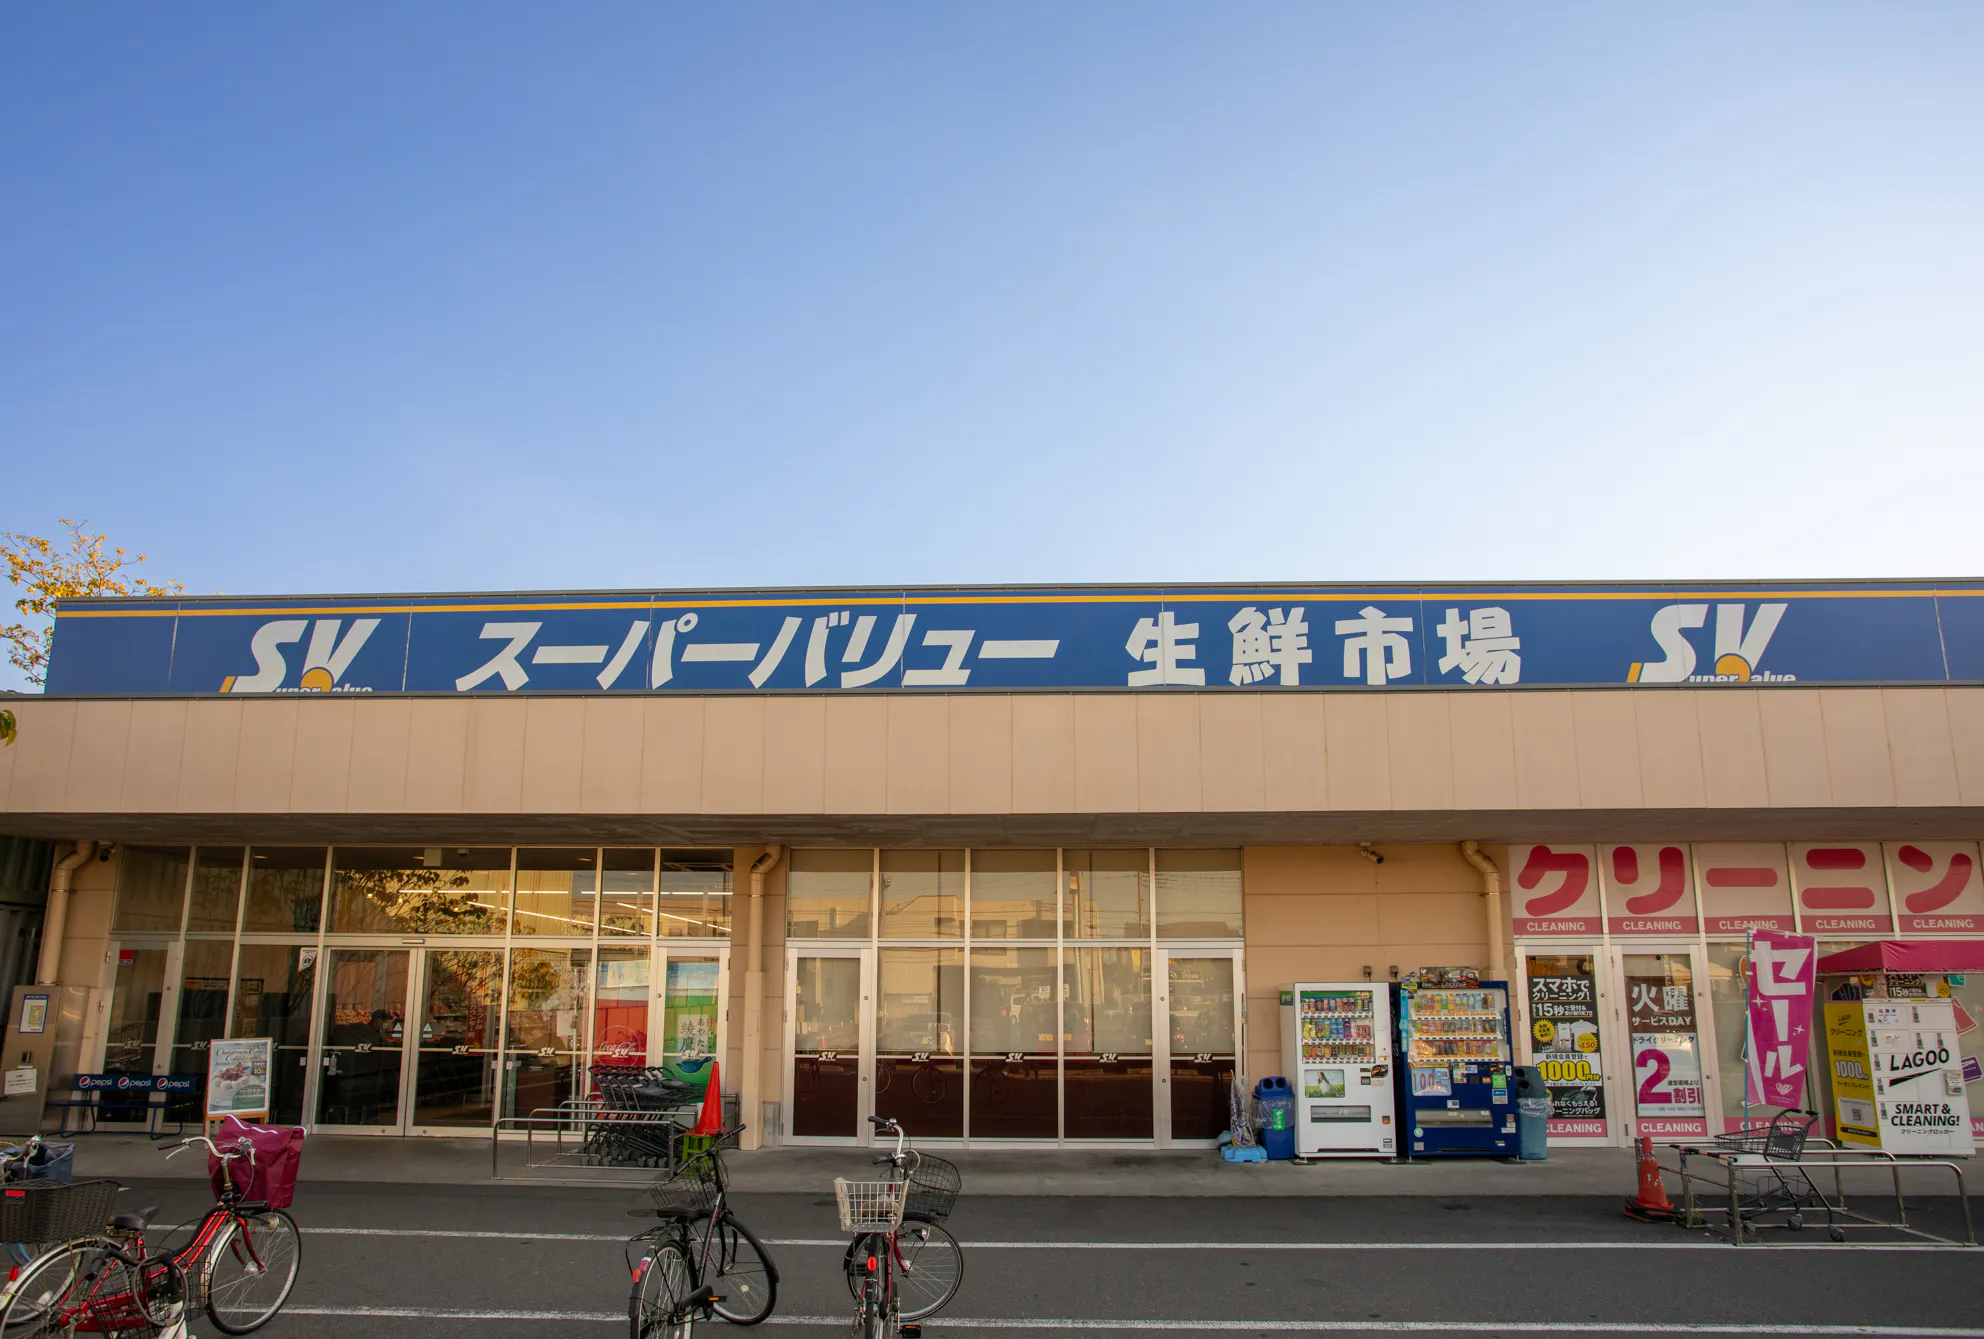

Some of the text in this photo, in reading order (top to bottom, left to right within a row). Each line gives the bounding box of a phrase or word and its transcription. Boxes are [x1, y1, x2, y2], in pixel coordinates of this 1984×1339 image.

[1639, 603, 1788, 682] SV
[455, 606, 1521, 691] スーパーバリュー 生鮮市場
[229, 619, 382, 692] SV
[1526, 921, 1586, 931] CLEANING
[1622, 921, 1682, 931] CLEANING
[1719, 919, 1778, 930] CLEANING
[1815, 919, 1876, 929] CLEANING
[1912, 918, 1974, 928] CLEANING
[1532, 977, 1590, 993] スマホで
[1532, 992, 1590, 1000] クリーニング!
[1631, 983, 1689, 1012] 火曜
[1751, 941, 1811, 1080] セール
[1631, 1016, 1692, 1026] サービスDAY
[1830, 1028, 1863, 1037] クリーニング
[1632, 1035, 1695, 1045] ドライクリーニング
[1889, 1048, 1950, 1072] LAGOO
[129, 1079, 151, 1087] pepsi
[168, 1080, 190, 1088] pepsi
[1895, 1103, 1951, 1115] SMART &
[1890, 1115, 1960, 1126] CLEANING!
[1640, 1123, 1701, 1132] CLEANING
